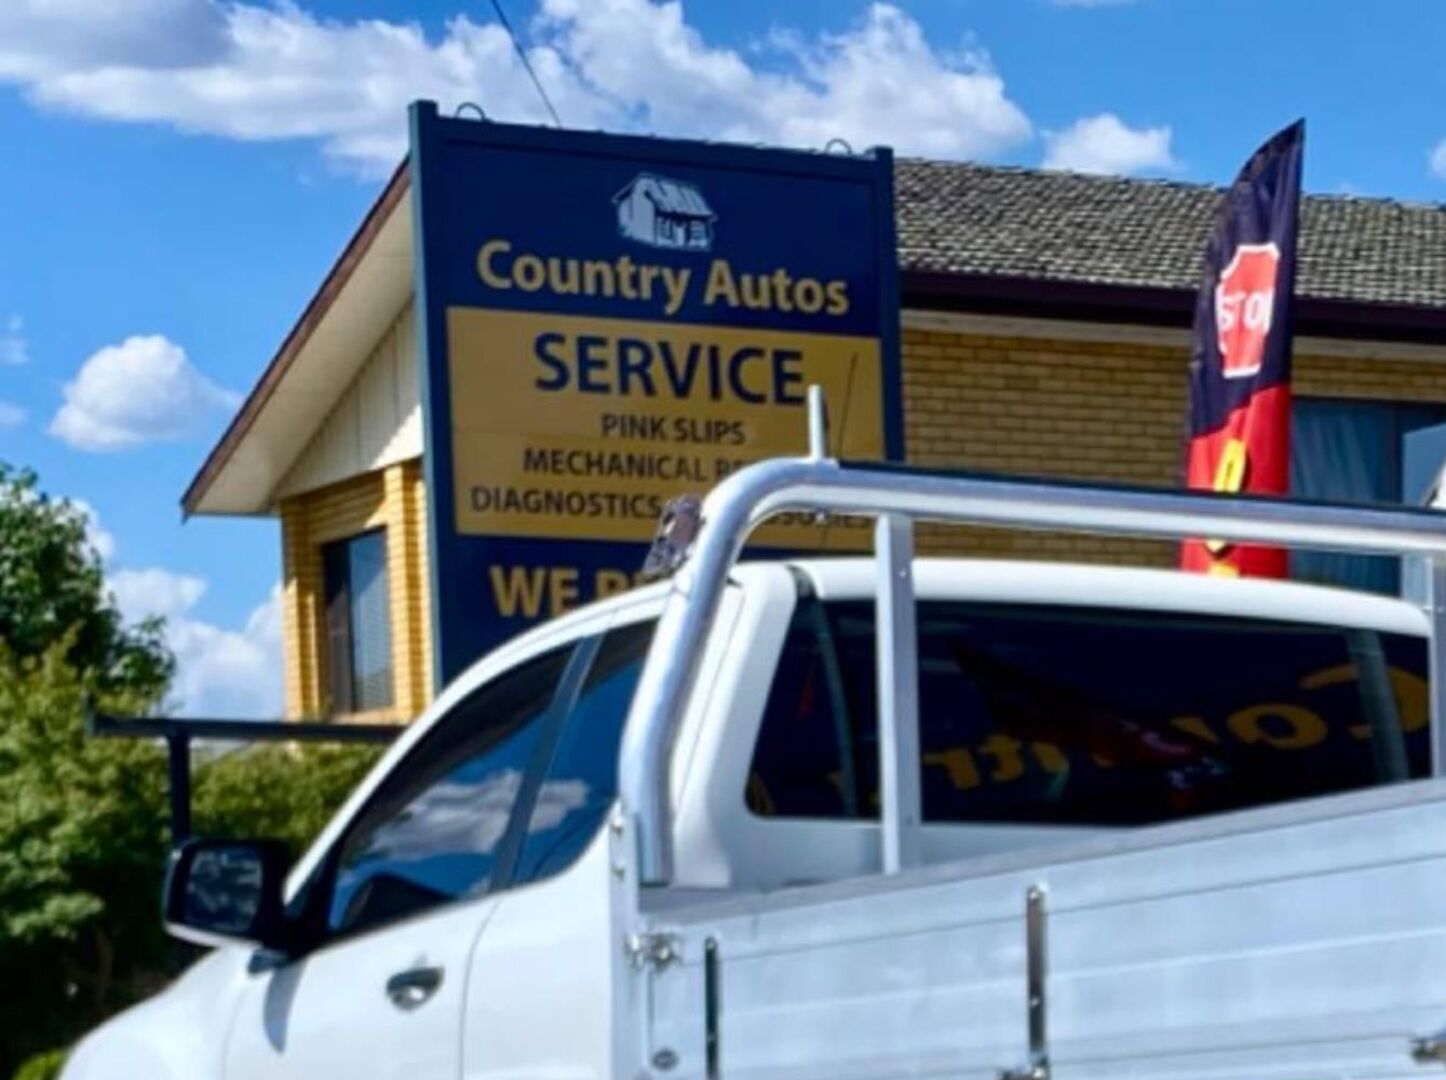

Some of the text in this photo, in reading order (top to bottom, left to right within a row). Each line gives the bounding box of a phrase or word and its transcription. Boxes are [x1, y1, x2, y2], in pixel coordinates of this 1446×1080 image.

[477, 239, 849, 315] Country Autos
[535, 332, 804, 405] SERVICE
[601, 413, 746, 446] PINK SLIPS
[523, 448, 708, 482] MECHANICAL
[470, 485, 660, 519] DIAGNOSTICS
[489, 565, 579, 618] WE
